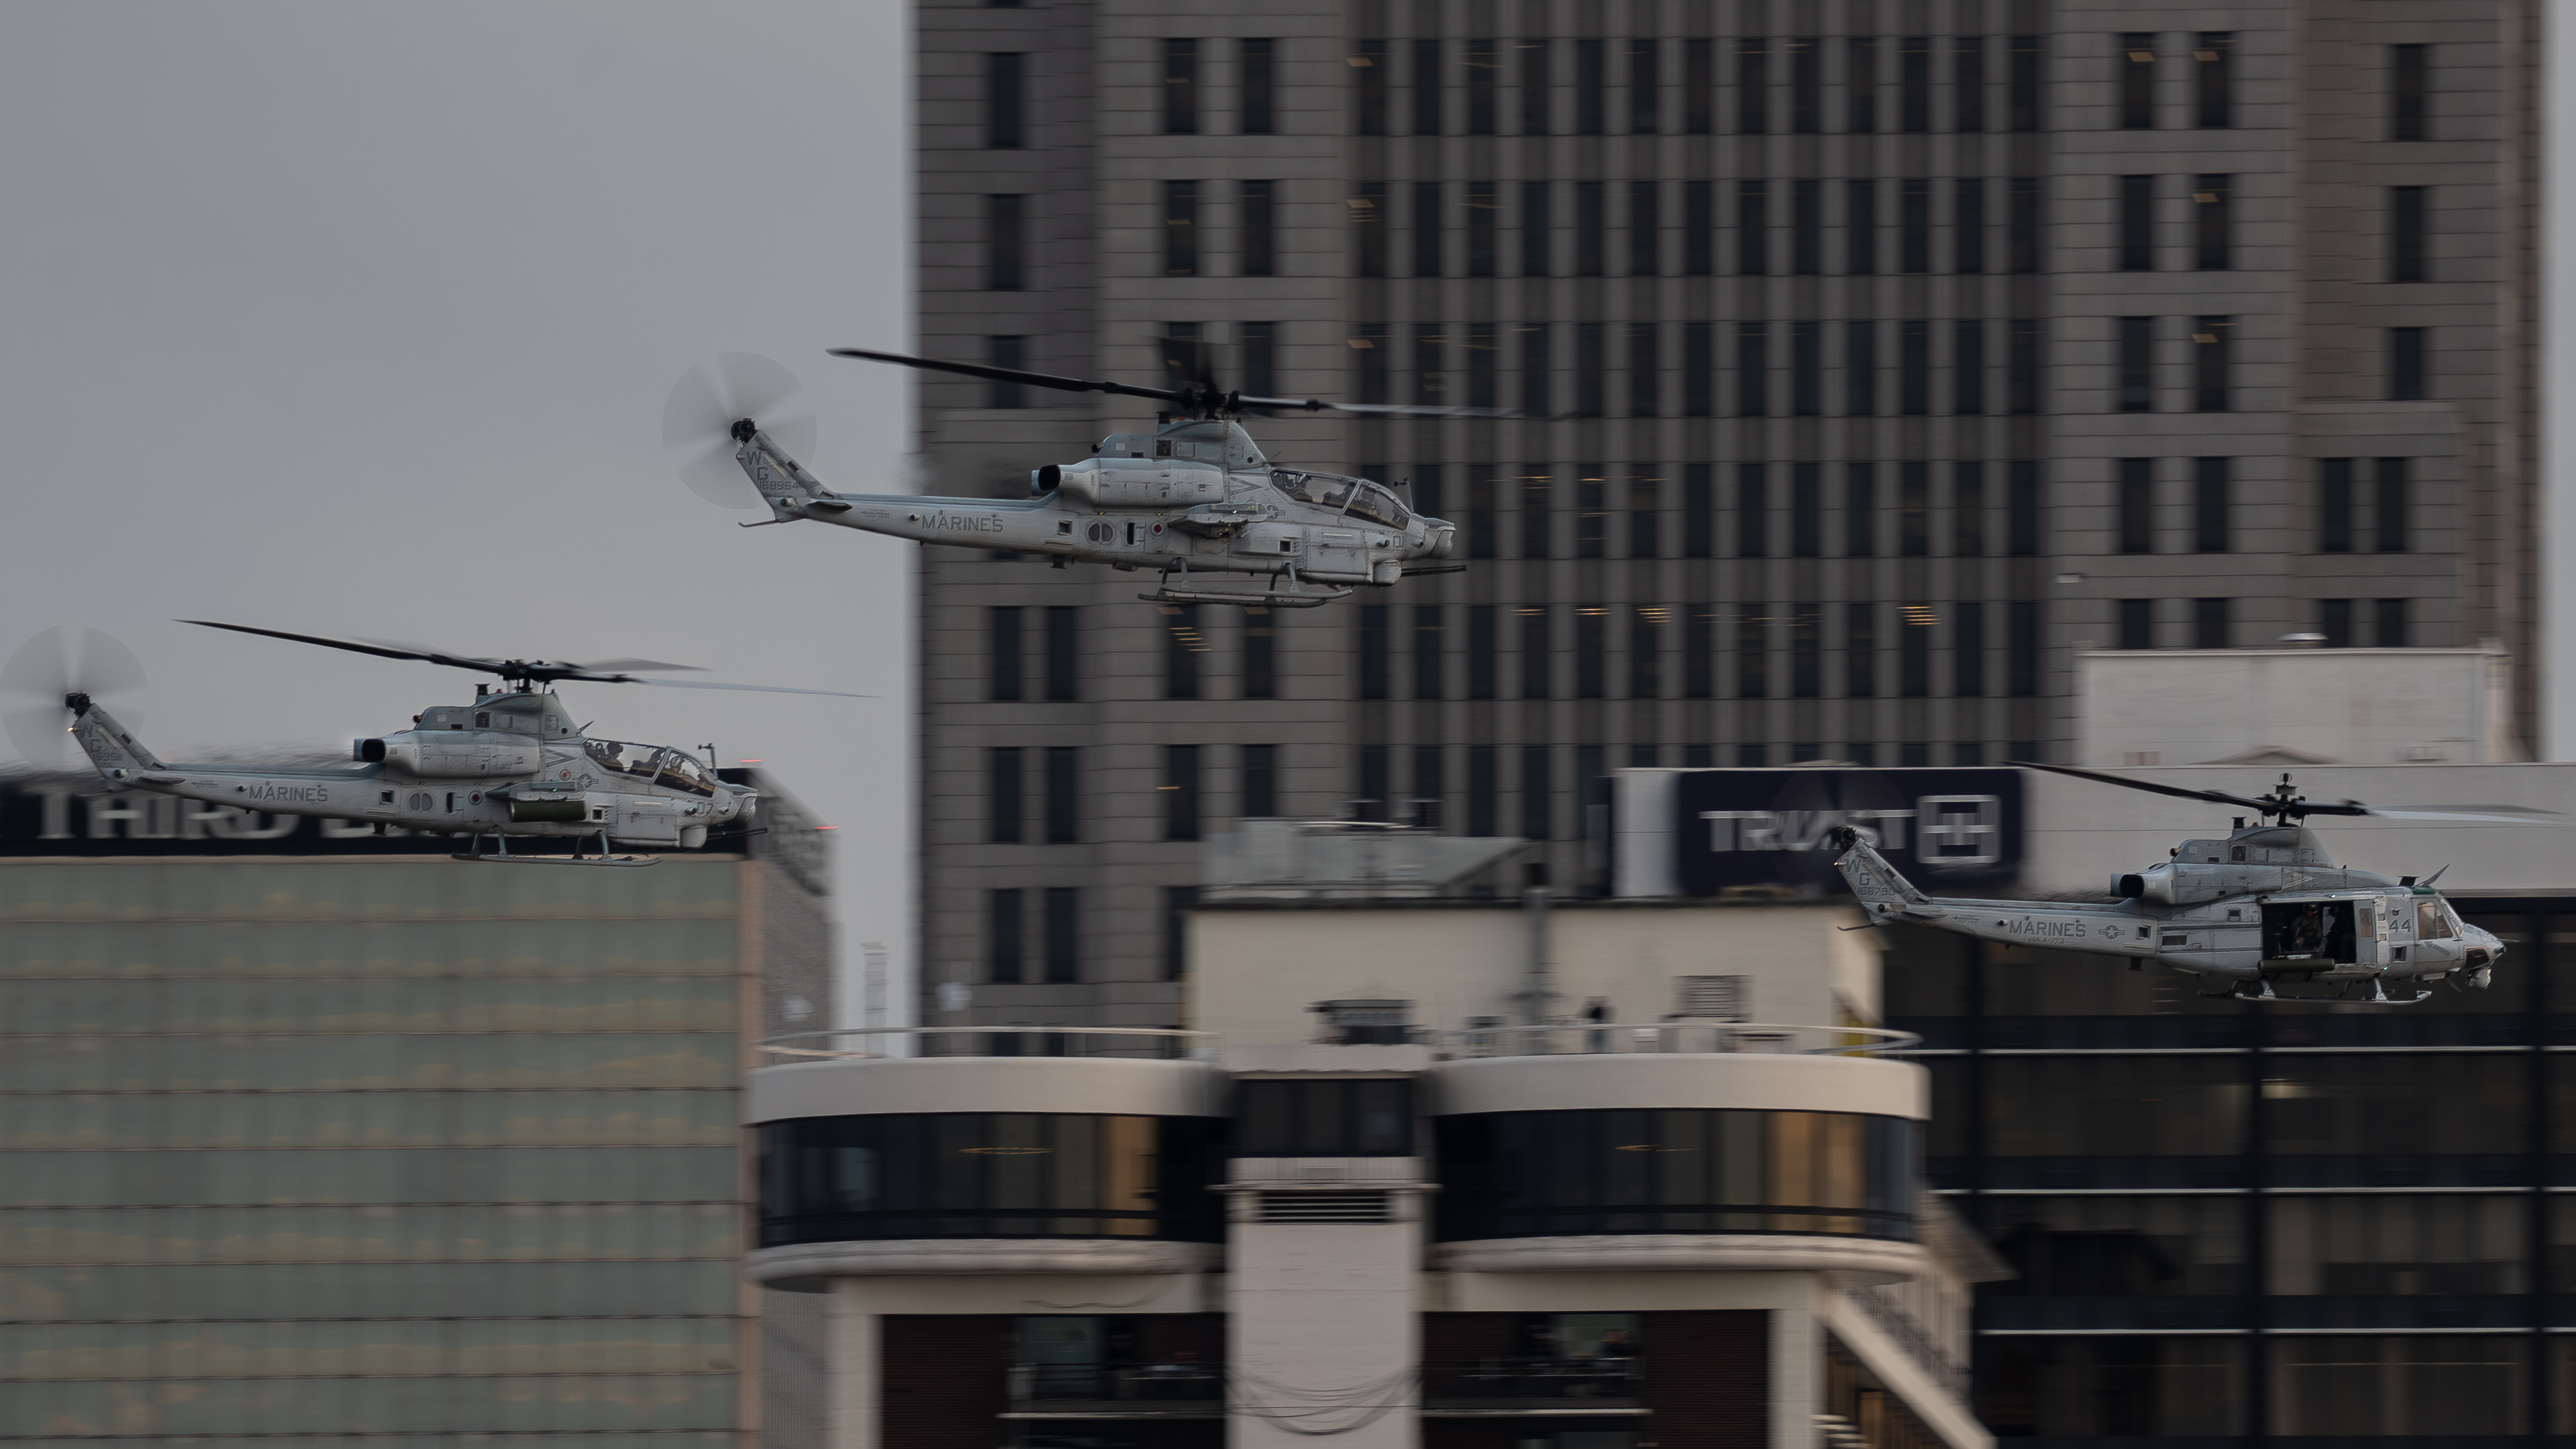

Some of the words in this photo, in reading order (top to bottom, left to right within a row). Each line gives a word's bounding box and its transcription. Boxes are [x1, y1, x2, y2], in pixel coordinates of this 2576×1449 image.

[747, 451, 761, 465] W
[757, 467, 769, 480] G
[922, 514, 1003, 532] MARINES
[91, 739, 101, 752] G
[249, 785, 328, 802] MARINES
[1846, 859, 1861, 872] W
[1860, 872, 1871, 886] G
[2009, 919, 2087, 937] MARINES
[2389, 918, 2411, 933] 44
